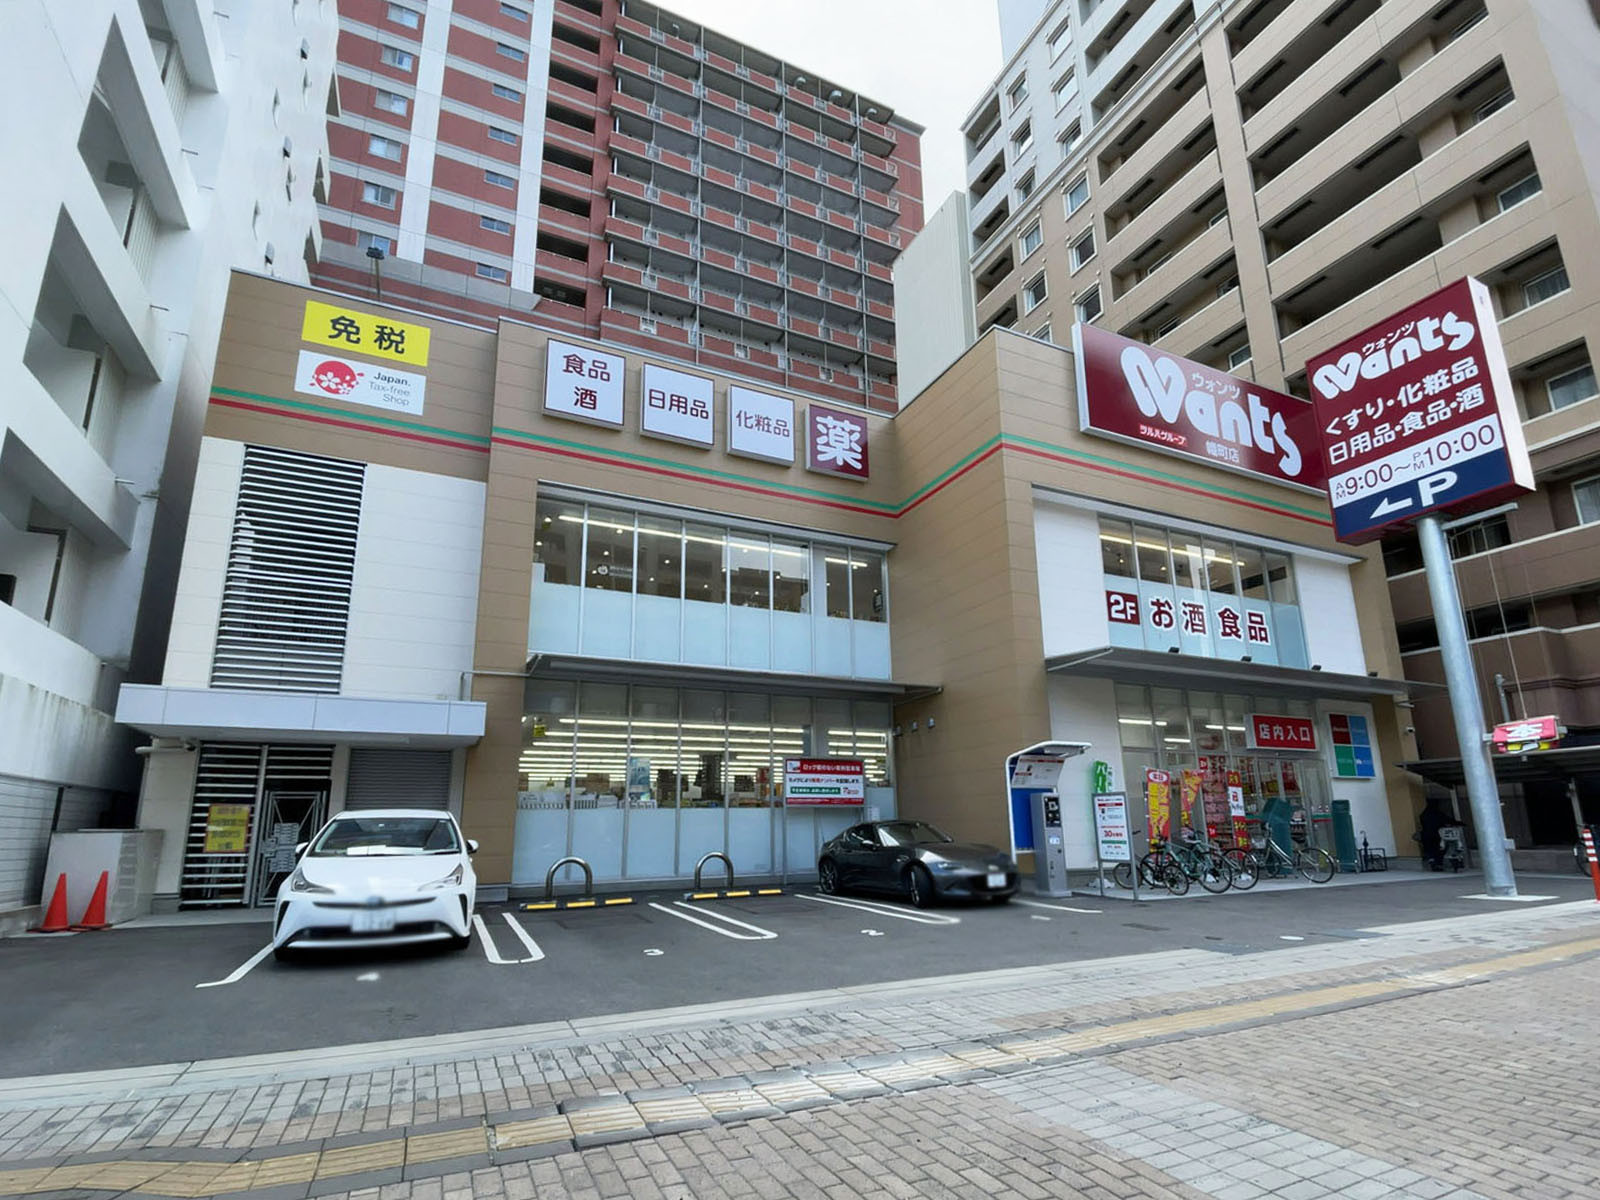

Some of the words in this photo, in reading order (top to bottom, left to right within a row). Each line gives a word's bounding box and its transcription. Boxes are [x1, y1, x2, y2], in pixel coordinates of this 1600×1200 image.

[328, 315, 405, 354] 免税
[1362, 321, 1415, 356] ウォンツ
[562, 353, 610, 382] 食品
[1313, 311, 1475, 400] Wants
[369, 381, 410, 396] Tax-free
[374, 372, 411, 387] Japan.
[383, 394, 410, 406] Shop
[574, 386, 597, 410] 酒
[649, 389, 709, 420] 日用品
[1120, 346, 1302, 477] Wants
[736, 409, 790, 438] 化粧品
[815, 415, 863, 470] 薬
[1417, 470, 1458, 508] P
[1110, 594, 1137, 620] 2F
[1259, 723, 1311, 742] 店内入口
